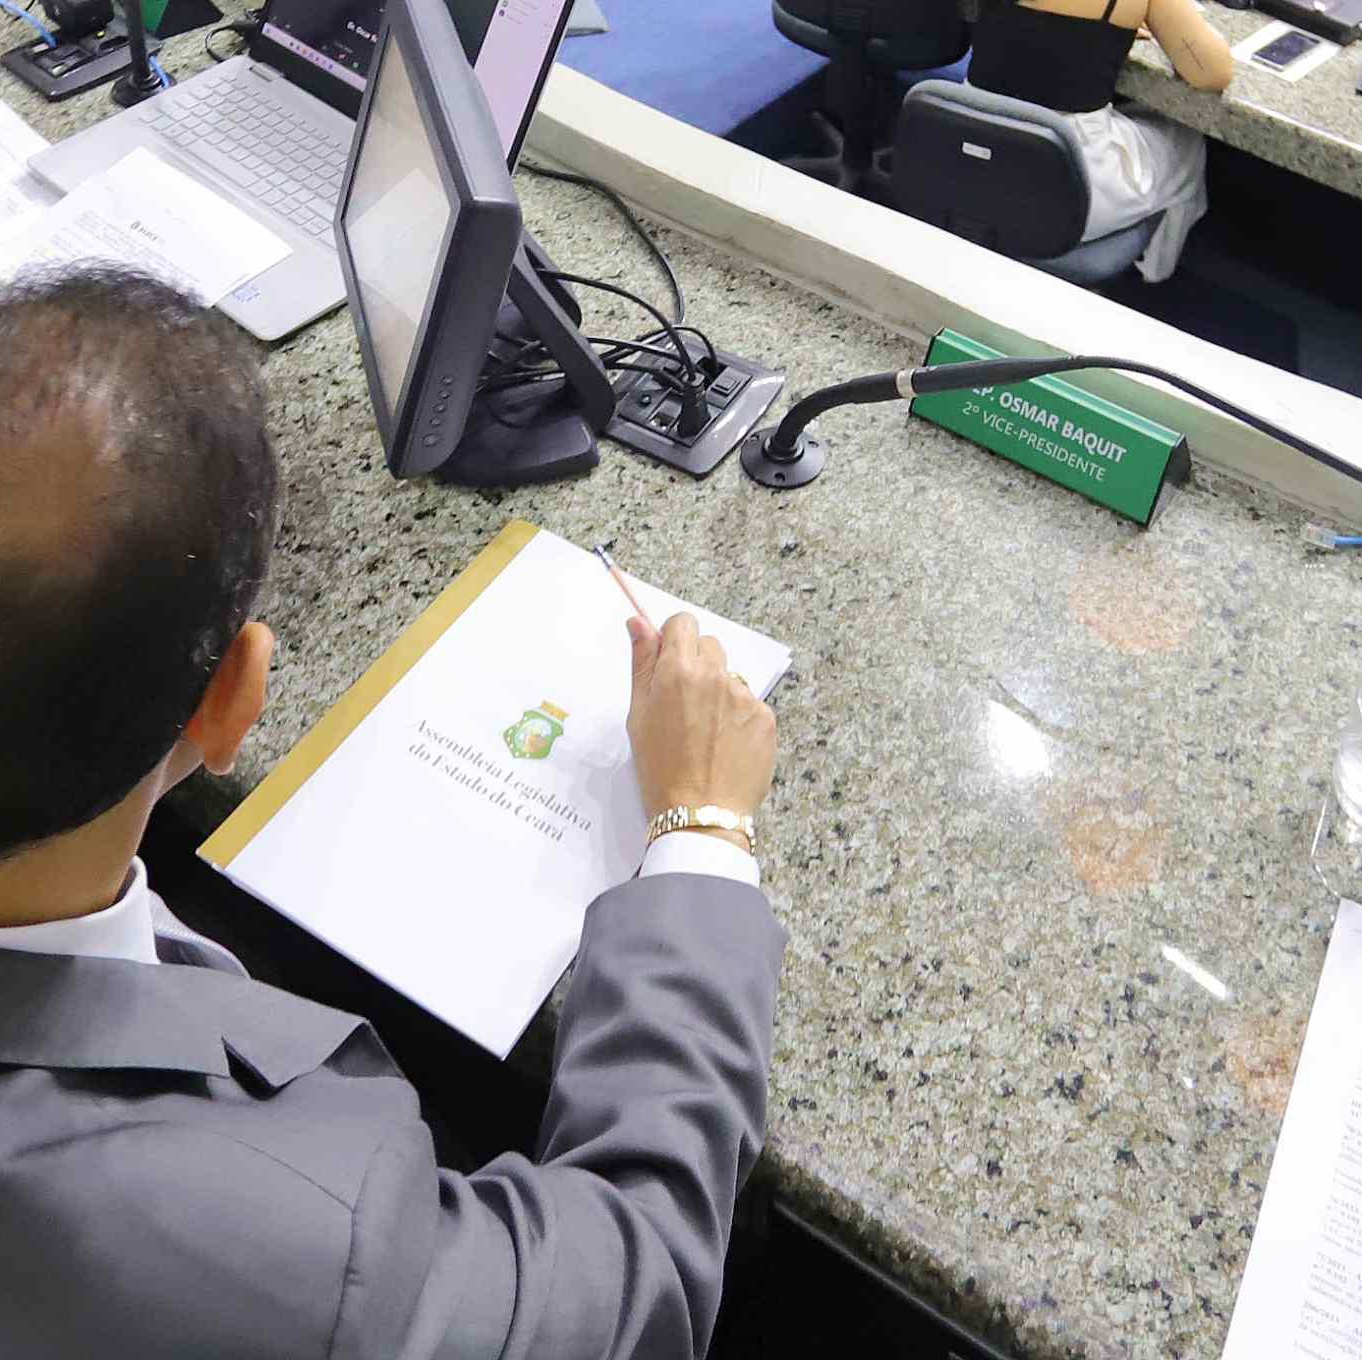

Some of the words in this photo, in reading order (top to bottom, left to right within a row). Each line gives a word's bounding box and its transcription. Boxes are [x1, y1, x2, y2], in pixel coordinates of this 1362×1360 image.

[982, 410, 1107, 481] VICE-PRESIDENTE
[999, 391, 1060, 432] OSMAR
[1061, 420, 1127, 463] BAQUIT
[408, 743, 431, 762] do
[432, 754, 488, 796] Estado
[489, 791, 512, 811] do
[514, 803, 568, 842] Ceará
[416, 719, 502, 779] Assembleia
[504, 771, 591, 831] Legislativa
